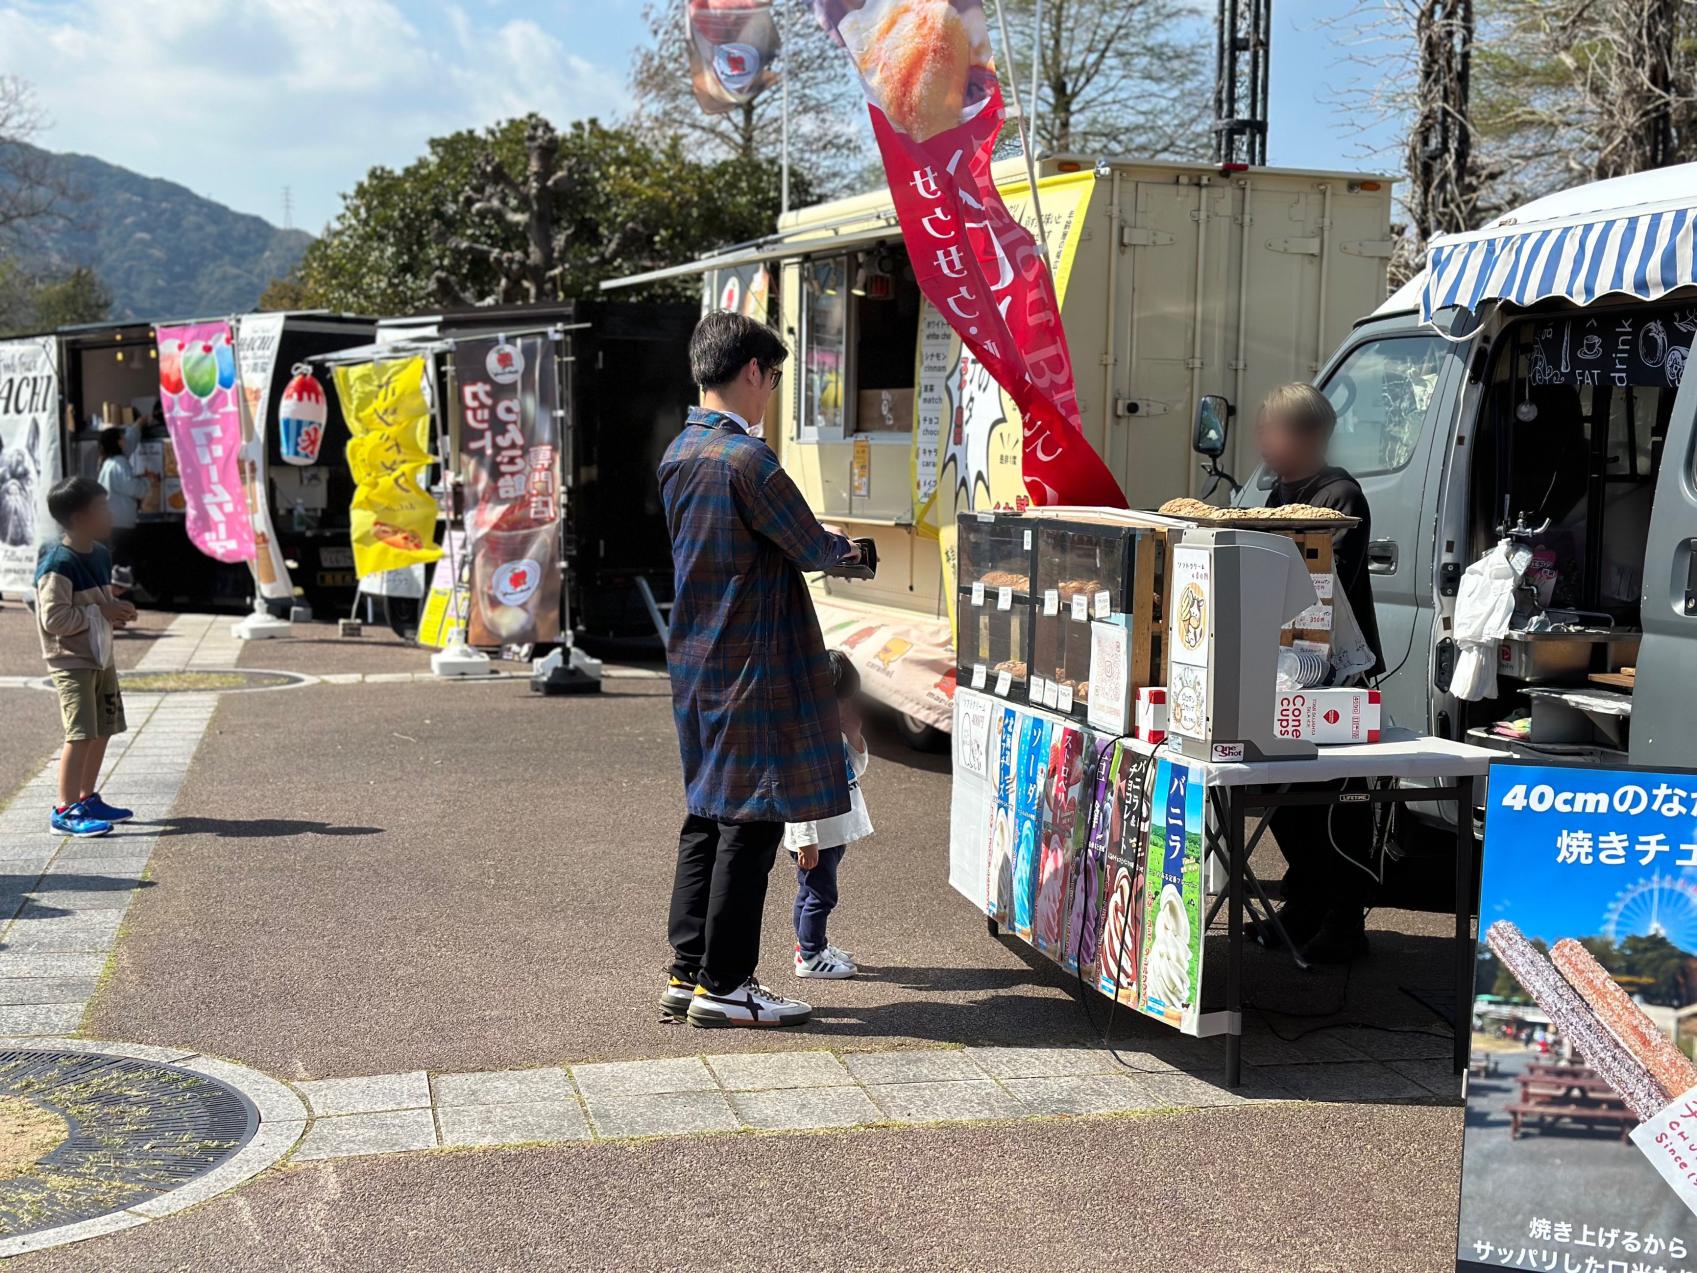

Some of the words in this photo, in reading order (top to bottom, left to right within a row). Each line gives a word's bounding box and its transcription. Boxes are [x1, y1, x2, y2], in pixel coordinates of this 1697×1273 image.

[1610, 318, 1633, 387] drink
[1277, 697, 1291, 737] cups
[1291, 694, 1306, 739] Cone
[1027, 728, 1042, 804] ソーダ
[1214, 744, 1237, 752] One
[1218, 750, 1242, 758] Shot
[1120, 763, 1139, 855] チョコレート
[1167, 775, 1186, 859] バニラ
[1501, 783, 1697, 817] 40cmのな
[1528, 1216, 1689, 1259] 焼き上げるから
